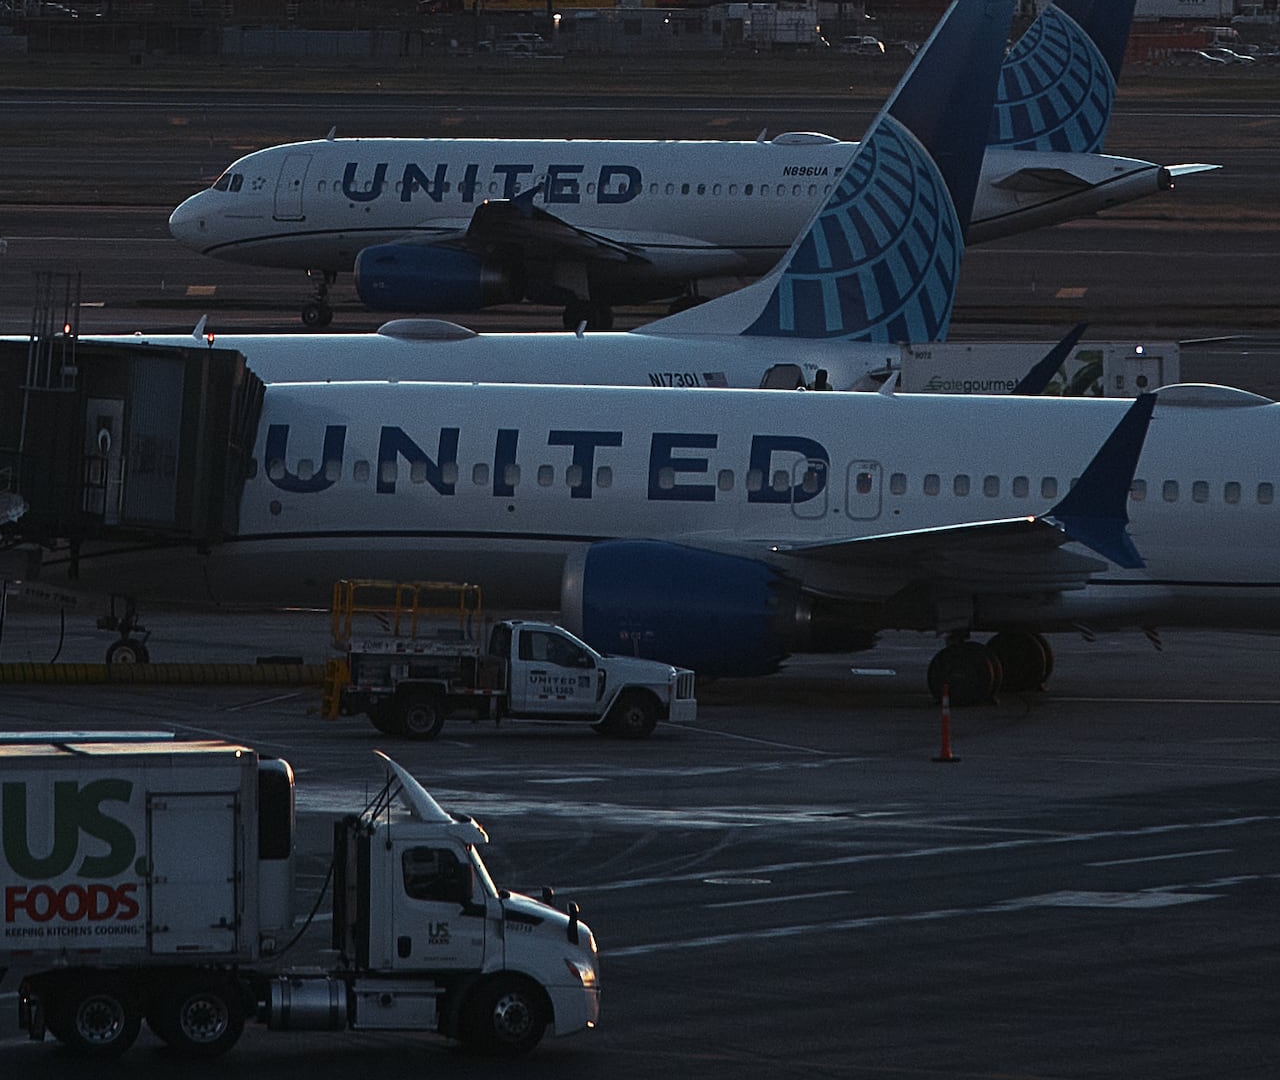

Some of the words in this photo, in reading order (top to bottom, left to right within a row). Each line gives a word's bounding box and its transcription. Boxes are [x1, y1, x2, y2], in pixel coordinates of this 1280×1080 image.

[783, 166, 828, 176] N896UA
[342, 162, 643, 205] UNITED
[648, 373, 700, 388] N17301
[264, 424, 831, 505] UNITED
[529, 676, 576, 685] UNITED
[5, 882, 140, 923] FOODS
[5, 926, 44, 938] KEEPING
[46, 925, 92, 937] KITCHENS
